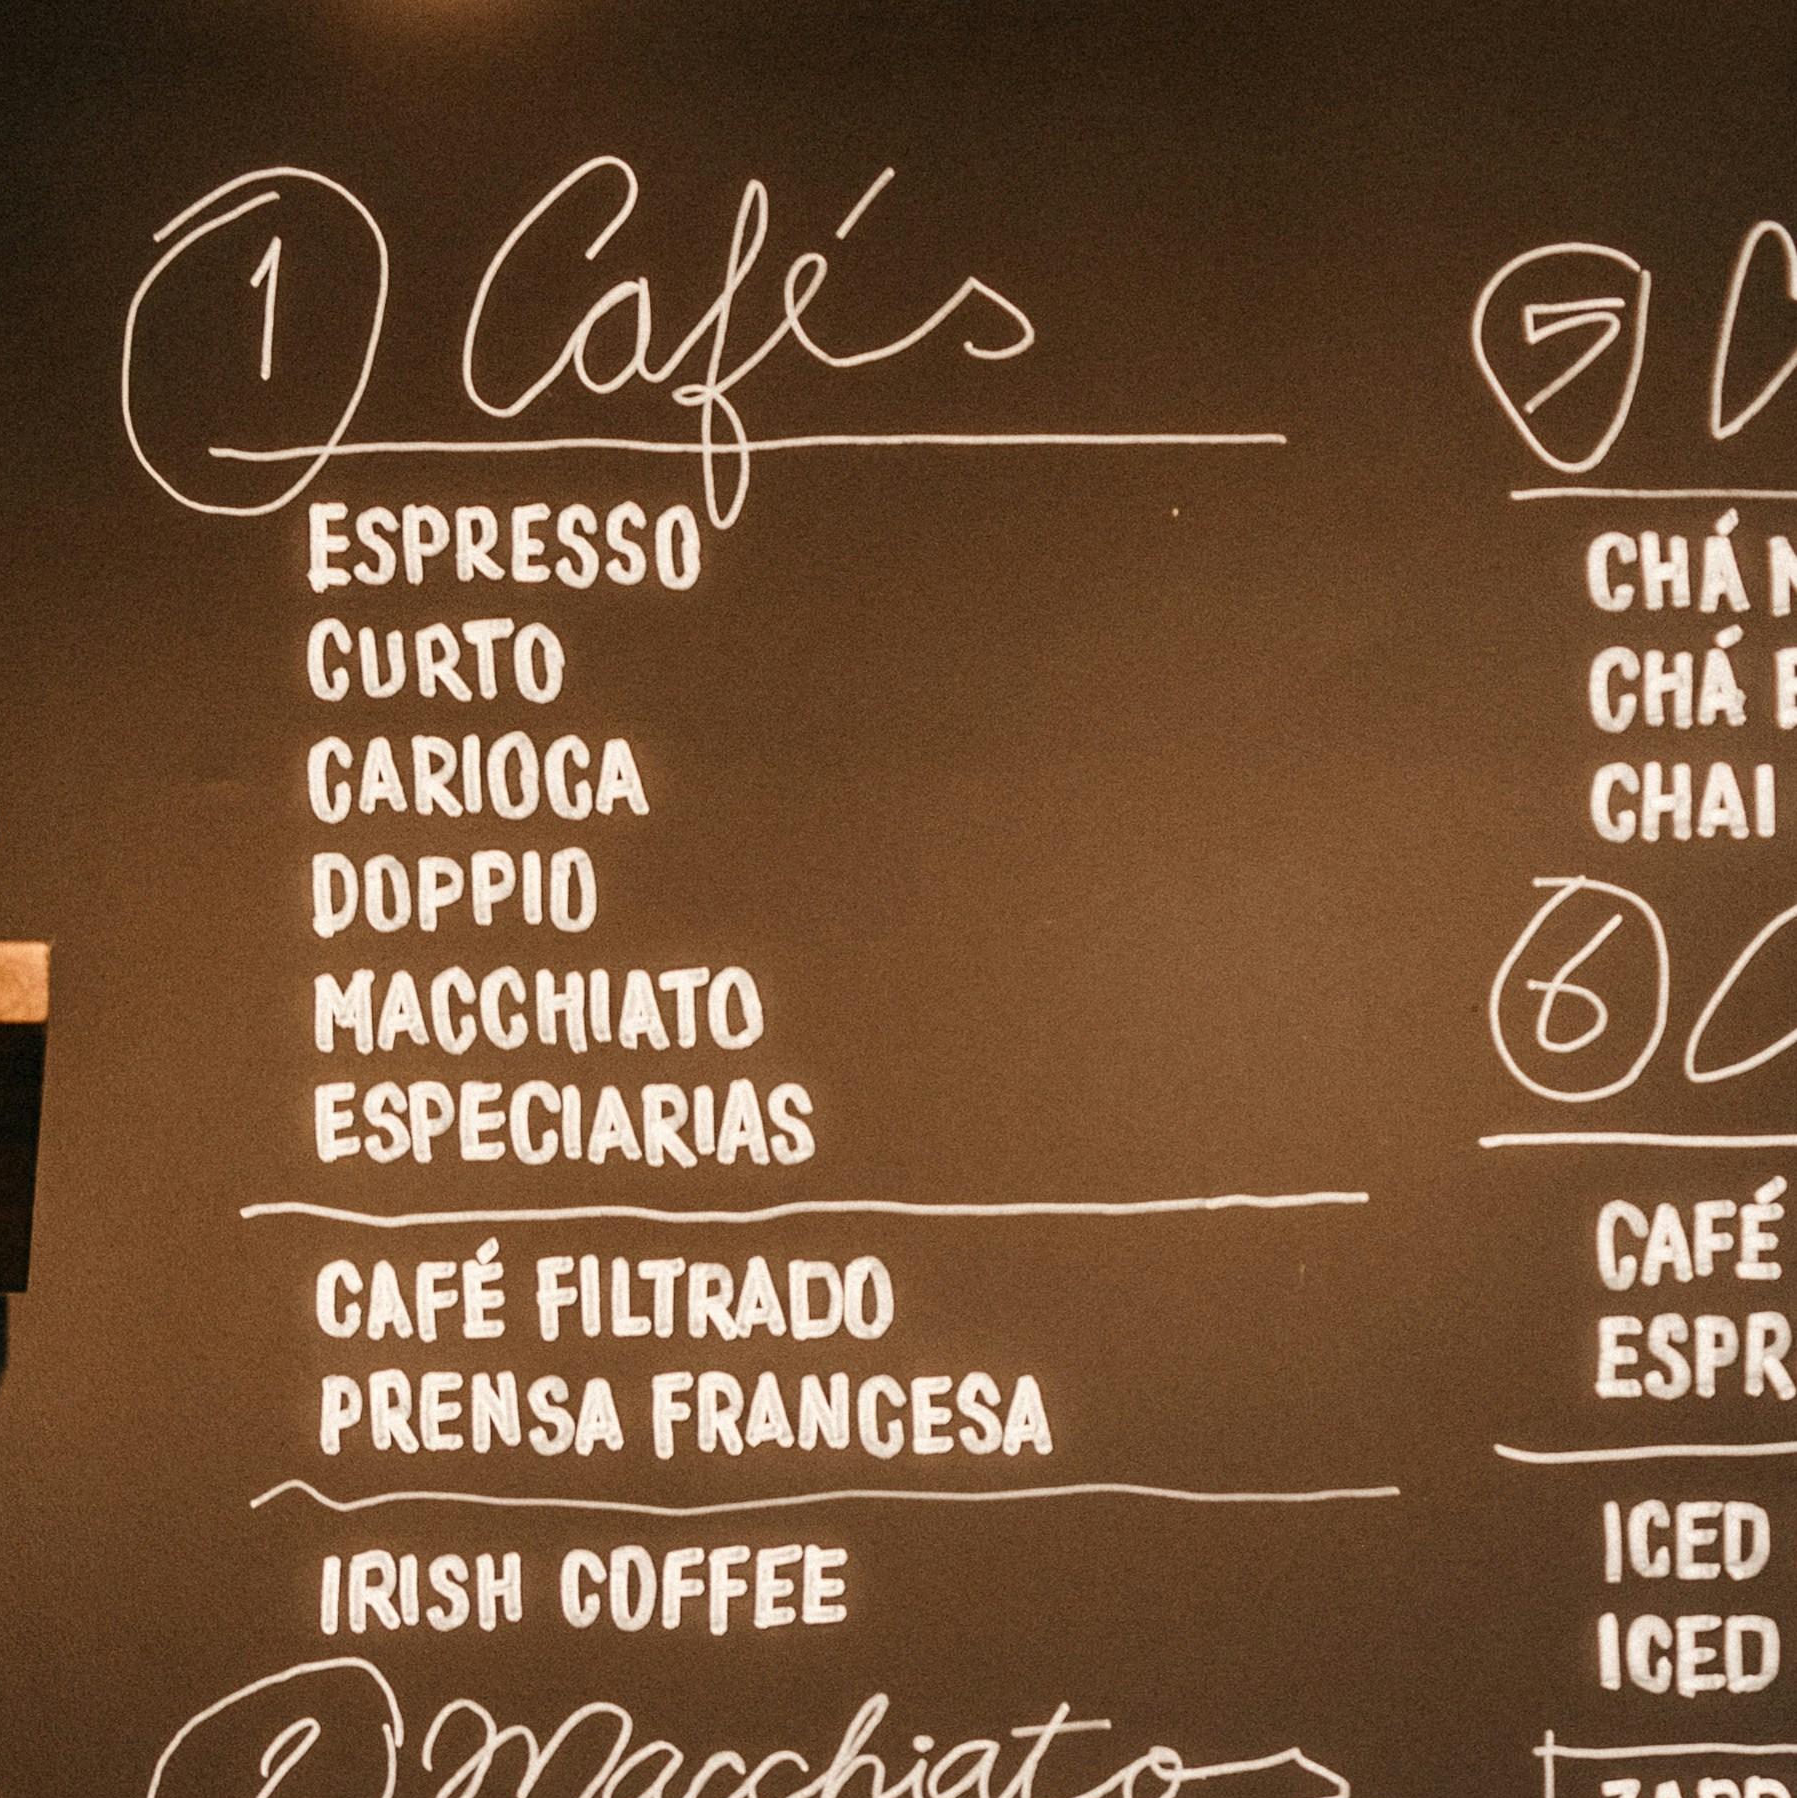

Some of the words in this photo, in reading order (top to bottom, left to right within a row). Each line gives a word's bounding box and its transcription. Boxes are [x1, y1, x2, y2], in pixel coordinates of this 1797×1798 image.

[248, 236, 282, 381] 1
[462, 156, 1036, 528] Cafés
[1522, 297, 1626, 414] 5
[306, 502, 701, 593] ESPRESSO
[1586, 508, 1751, 613] CHÁ
[307, 618, 565, 704] CURTO
[1588, 624, 1747, 732] CHÁ
[307, 731, 650, 824] CARIOCA
[1590, 761, 1775, 842] CHAI
[312, 847, 597, 939] DOPPIO
[314, 966, 764, 1055] MACCHIATO
[1525, 913, 1624, 1054] 6
[314, 1078, 815, 1168] ESPECIARIAS
[1596, 1175, 1787, 1290] CAFÉ
[315, 1237, 505, 1343] CAFÉ
[536, 1254, 894, 1342] FILTRADO
[1595, 1311, 1797, 1400] ESPR
[320, 1368, 624, 1456] PRENSA
[652, 1371, 1053, 1460] FRANCESA
[1603, 1499, 1770, 1583] ICED
[320, 1549, 523, 1635] IRISH
[560, 1544, 848, 1636] COFFEE
[1597, 1612, 1780, 1698] ICED
